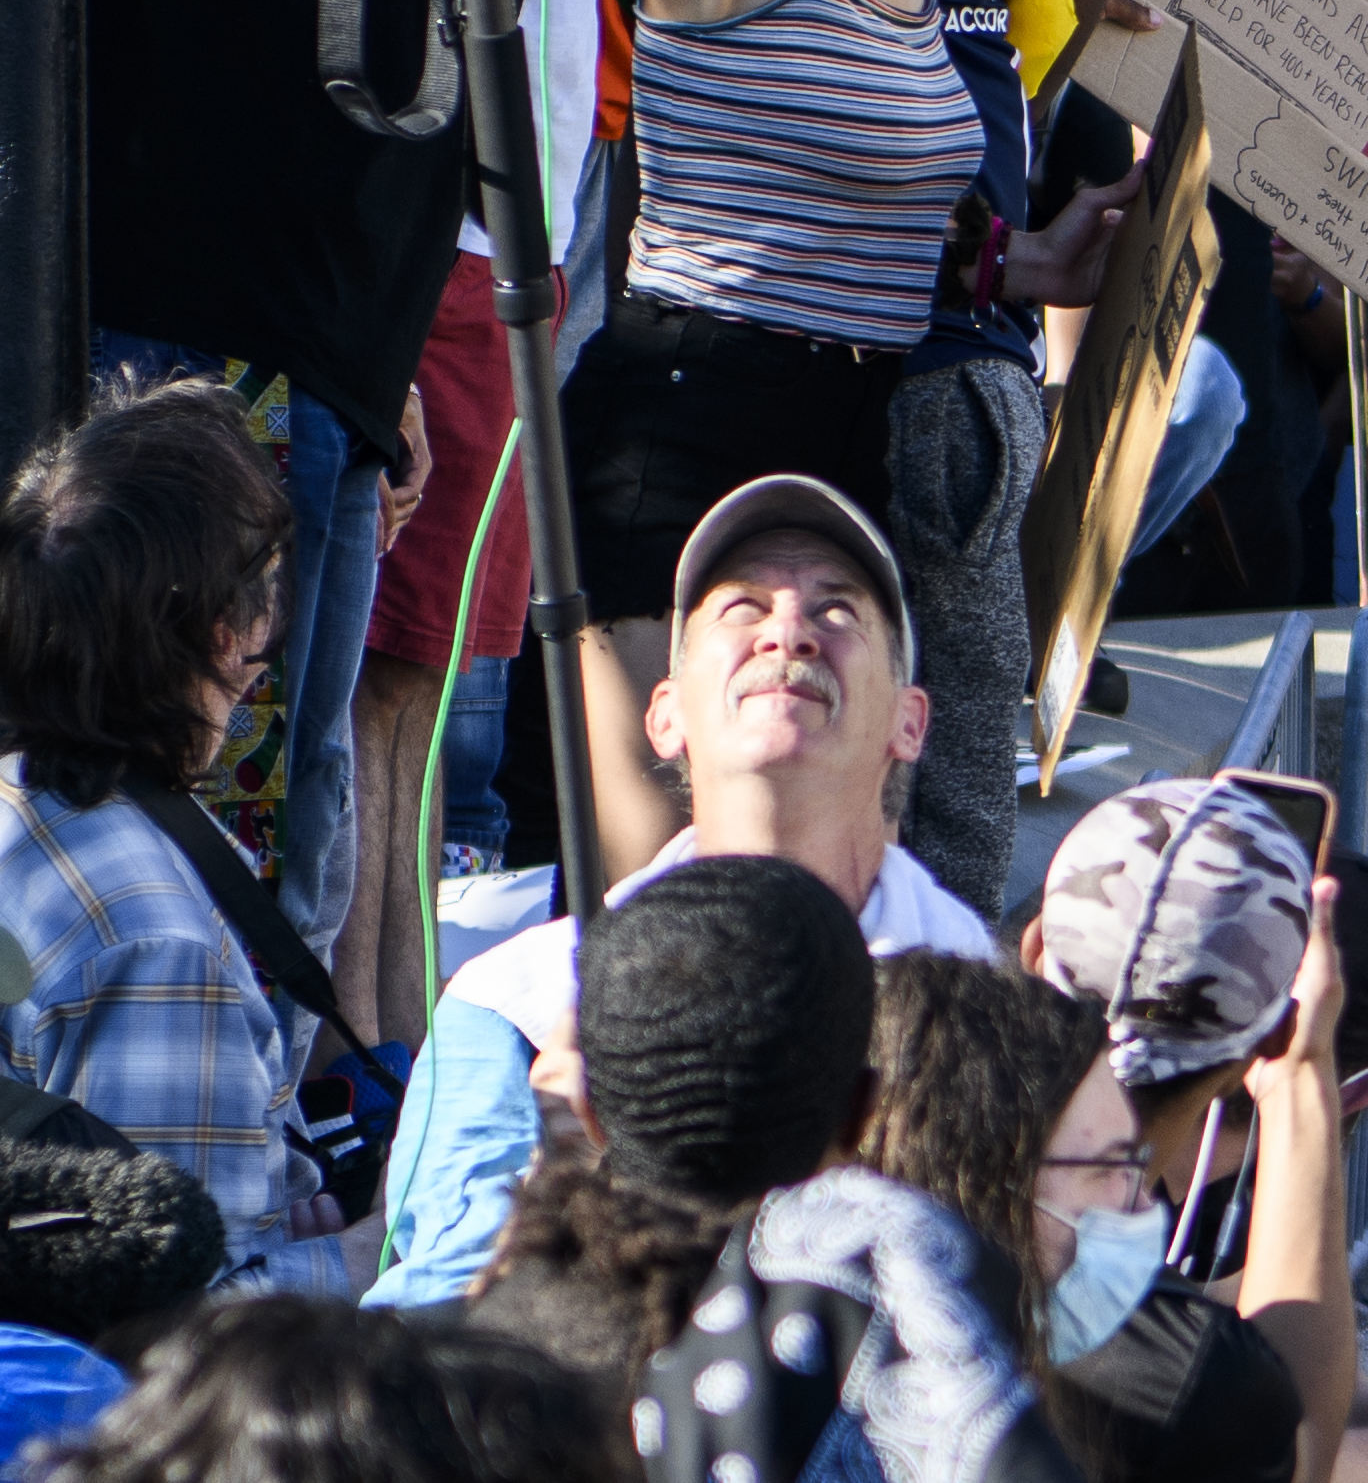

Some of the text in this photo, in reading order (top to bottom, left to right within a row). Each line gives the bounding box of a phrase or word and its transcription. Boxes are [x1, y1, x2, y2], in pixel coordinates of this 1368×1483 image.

[1293, 16, 1334, 63] BEEN
[1246, 20, 1276, 56] FOR
[1279, 48, 1311, 81] 400+
[1312, 76, 1368, 129] YEARS!!
[1250, 169, 1298, 221] Queens
[1316, 187, 1353, 228] these
[1314, 218, 1355, 267] Kings
